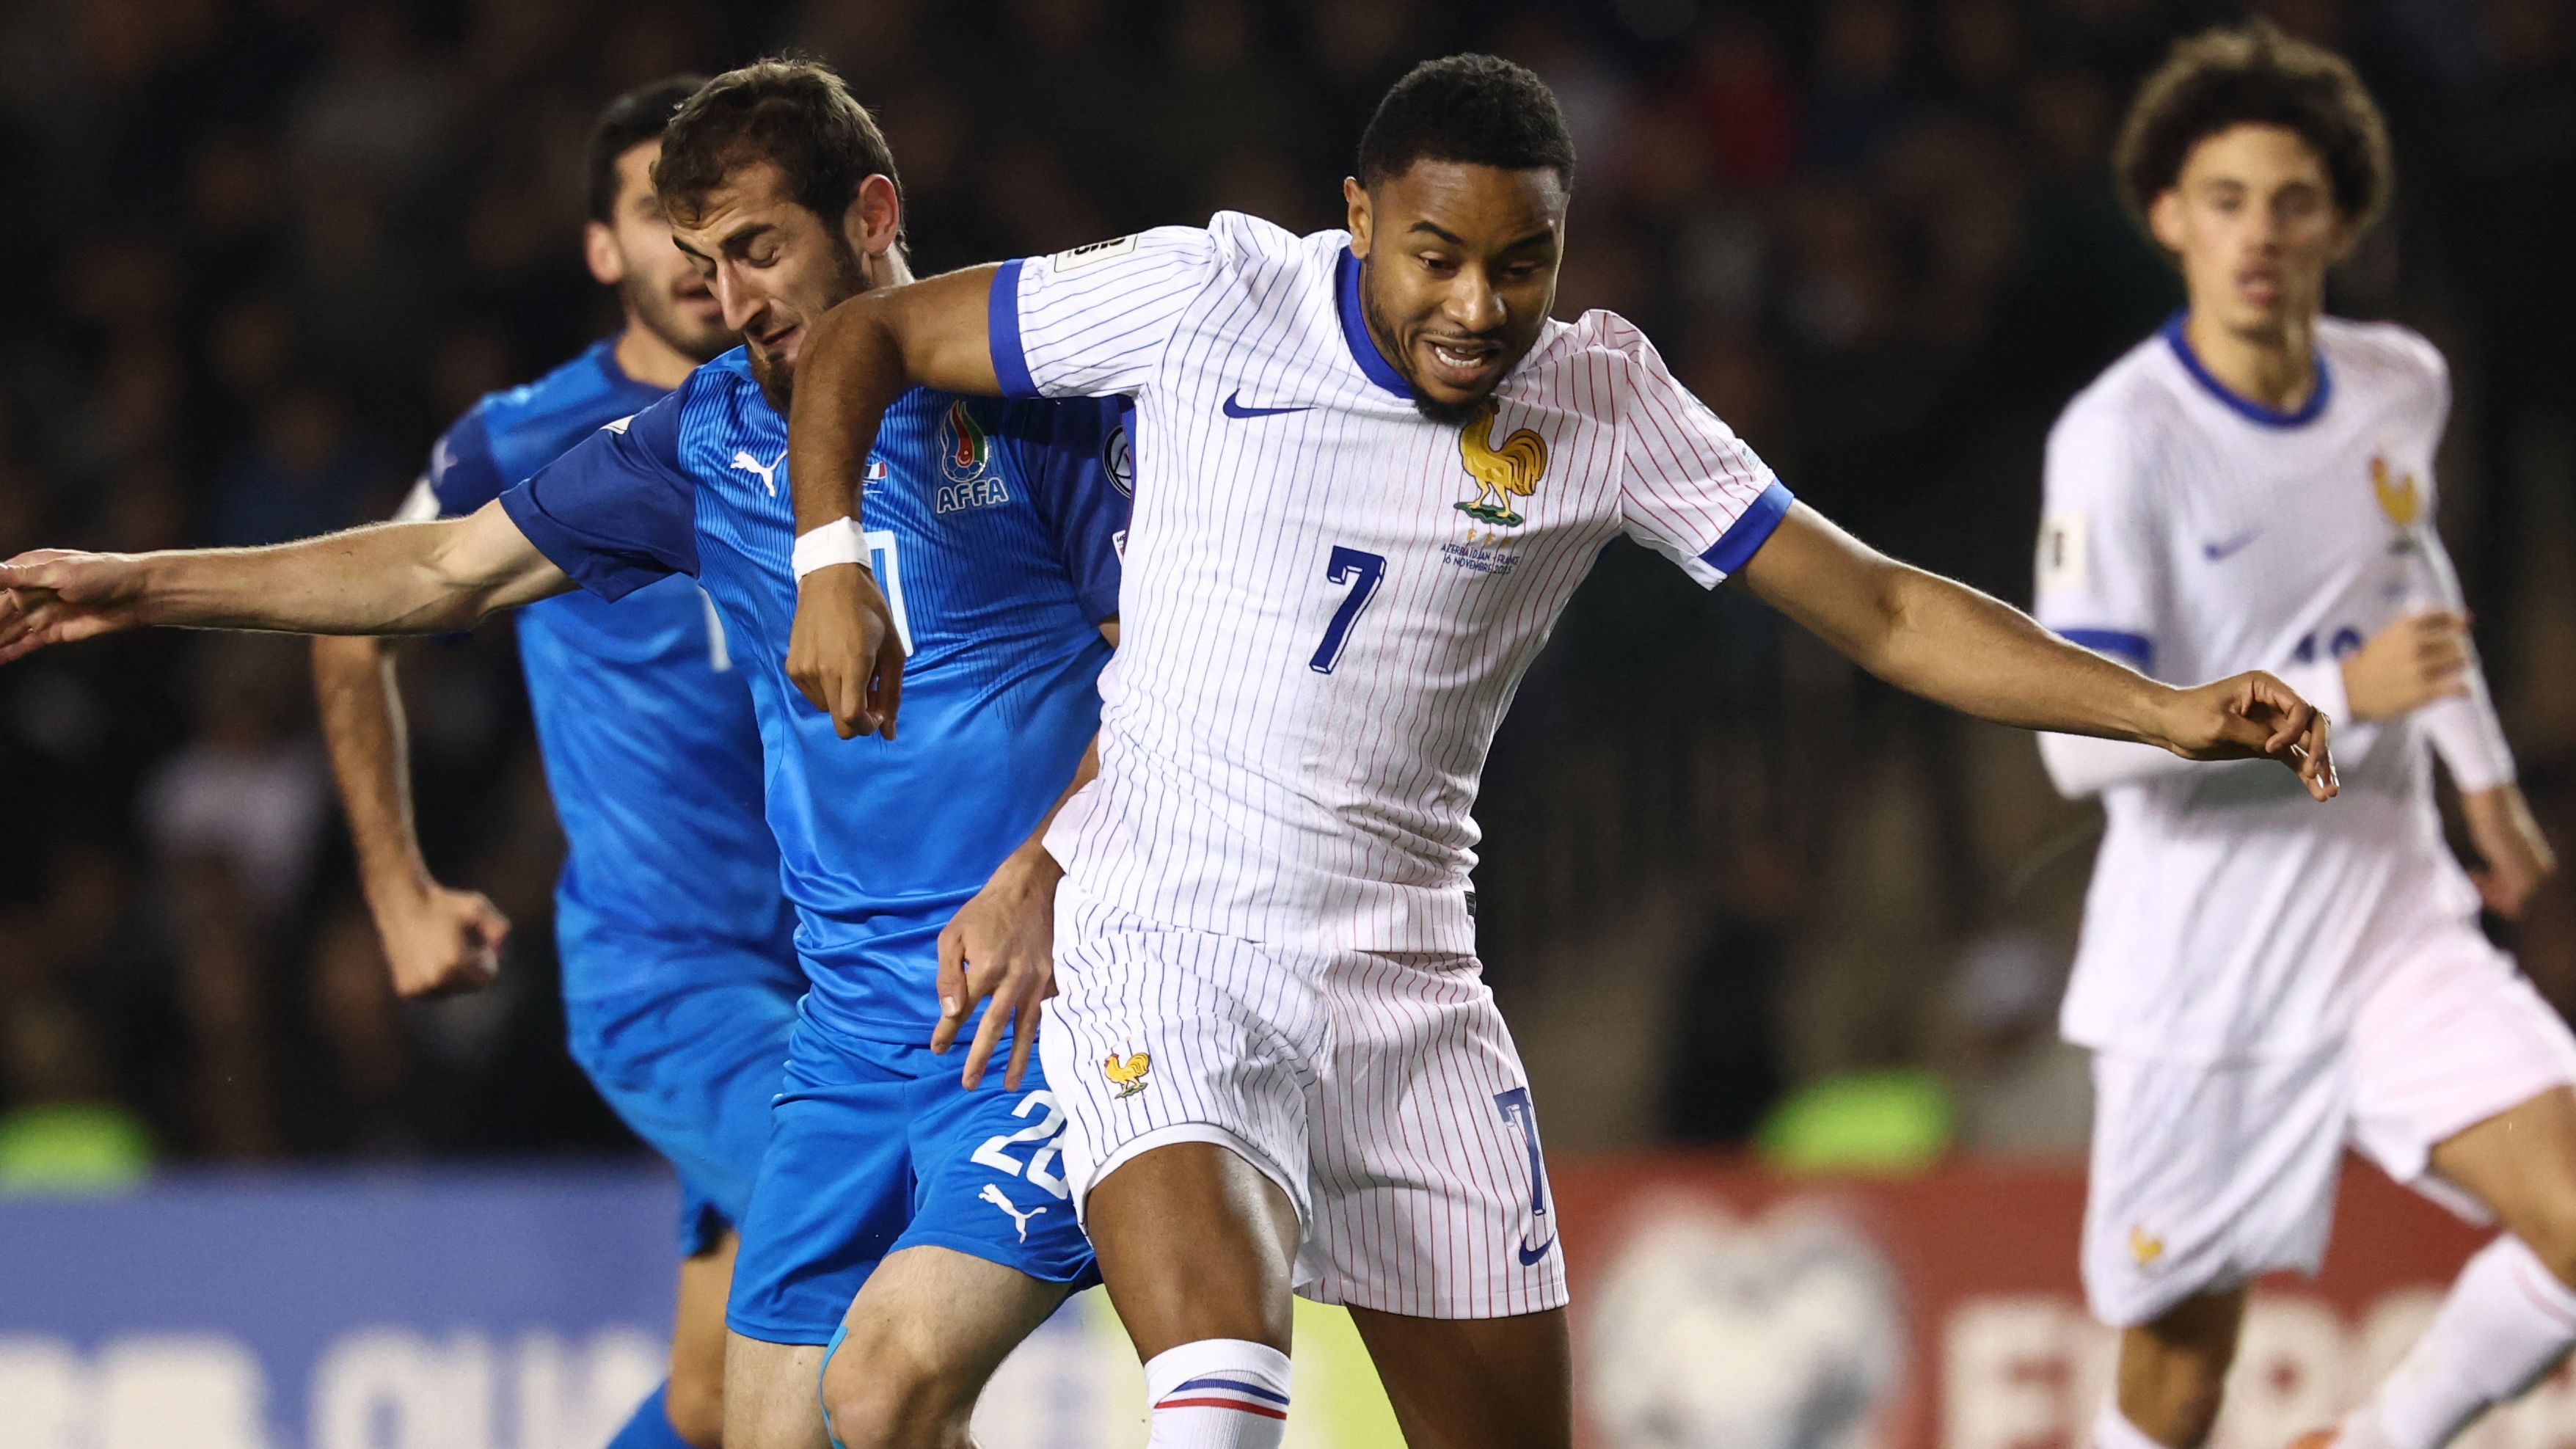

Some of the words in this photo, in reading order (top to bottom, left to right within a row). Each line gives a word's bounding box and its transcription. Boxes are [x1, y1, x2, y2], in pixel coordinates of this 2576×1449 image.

[936, 477, 1009, 514] AFFA
[1453, 556, 1492, 572] NOVEMBRE
[1309, 545, 1387, 675] 7
[1493, 1087, 1546, 1216] 7
